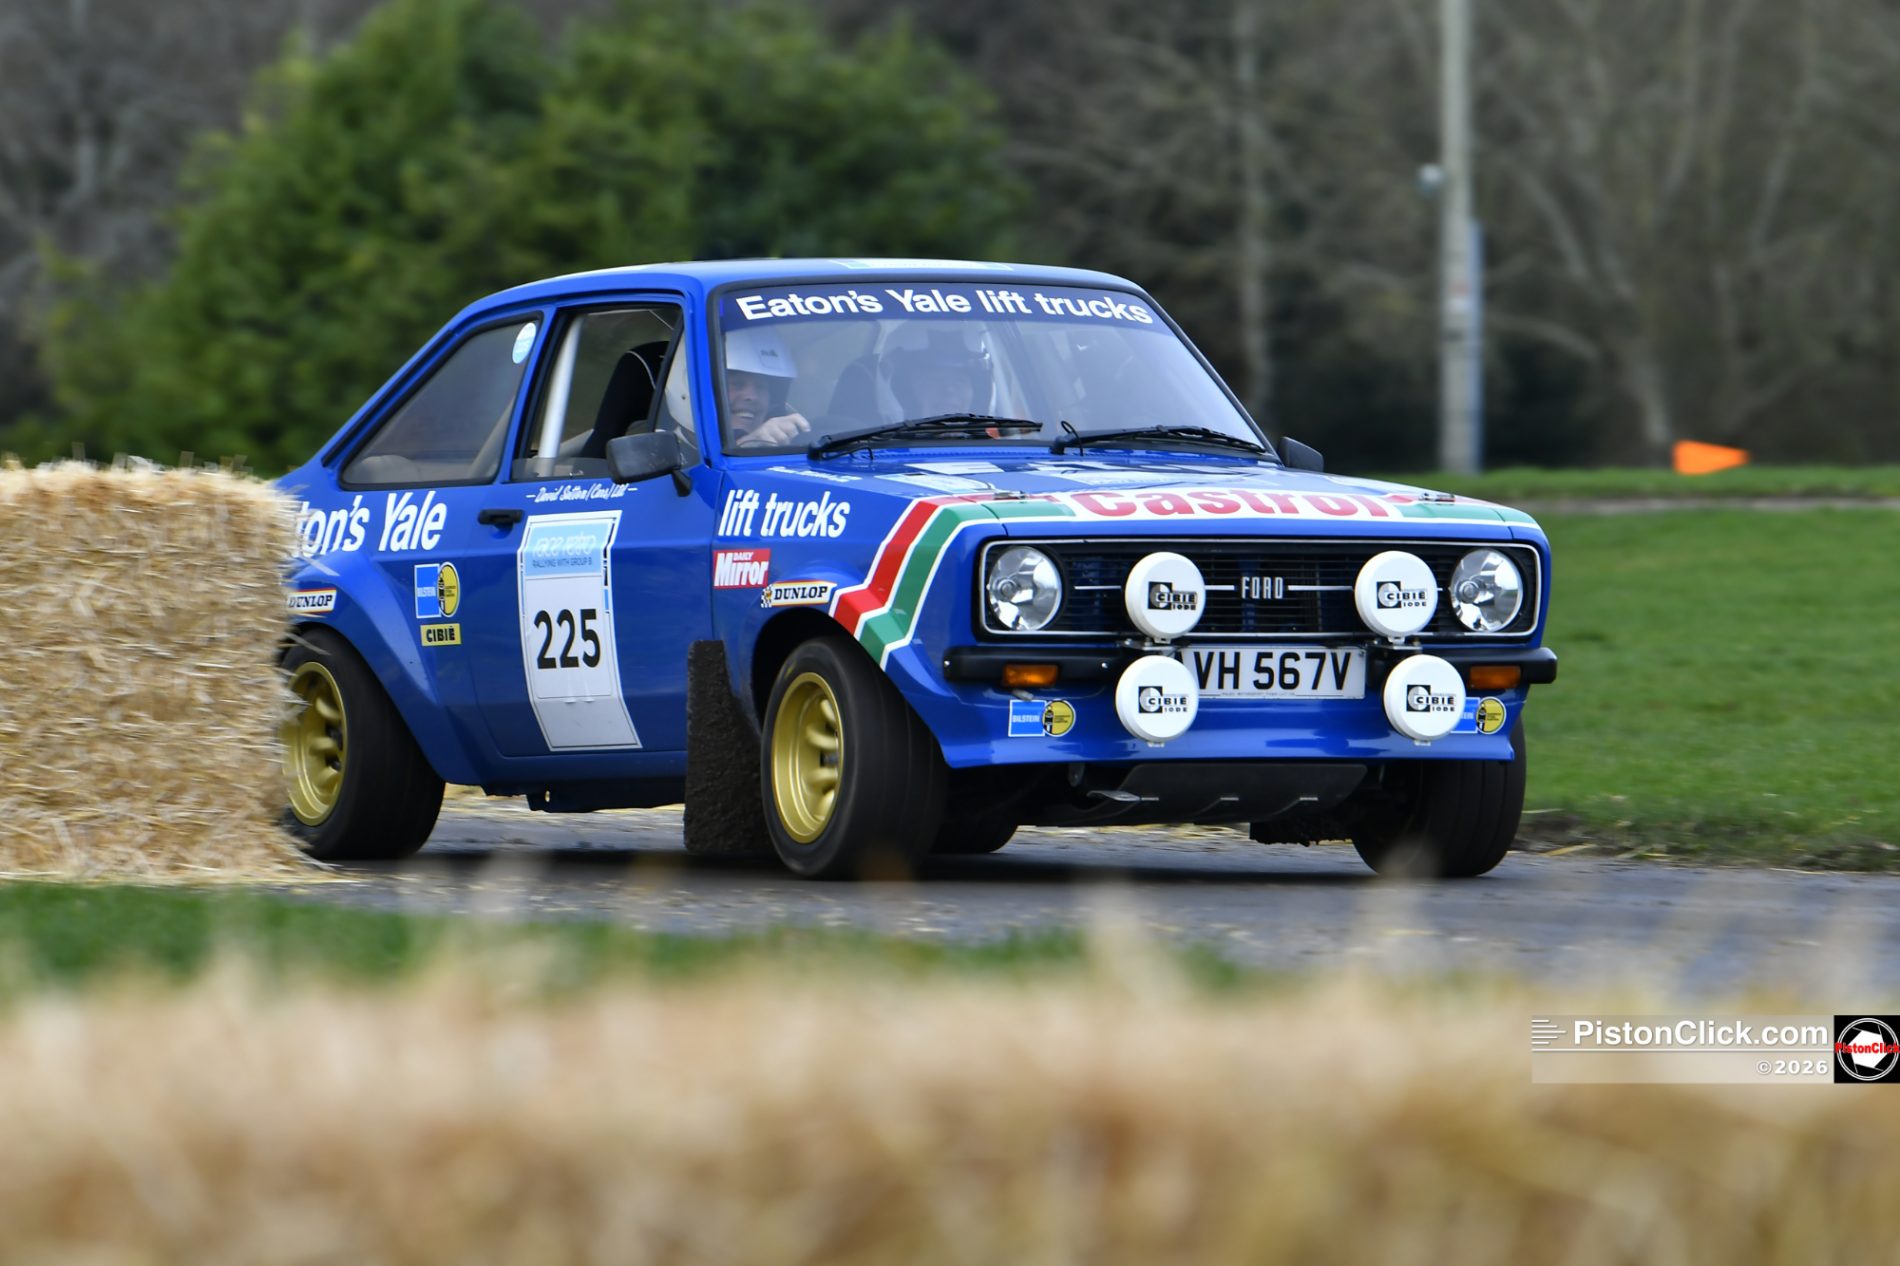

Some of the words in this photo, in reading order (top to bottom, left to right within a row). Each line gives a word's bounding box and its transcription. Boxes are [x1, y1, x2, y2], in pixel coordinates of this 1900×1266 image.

[736, 290, 883, 320] Eaton's
[885, 289, 971, 312] Yale
[975, 290, 1032, 314] lift
[1034, 293, 1153, 324] trucks
[718, 489, 760, 536] lift
[760, 491, 850, 538] trucks
[1070, 490, 1390, 517] Castrol
[378, 490, 447, 552] Yale
[713, 552, 769, 586] Mirror
[733, 551, 754, 561] DAILY
[288, 594, 333, 608] DUNLOP
[773, 586, 828, 600] DUNLOP
[1241, 576, 1283, 599] FORD
[533, 608, 601, 670] 225
[1253, 651, 1351, 690] 567V
